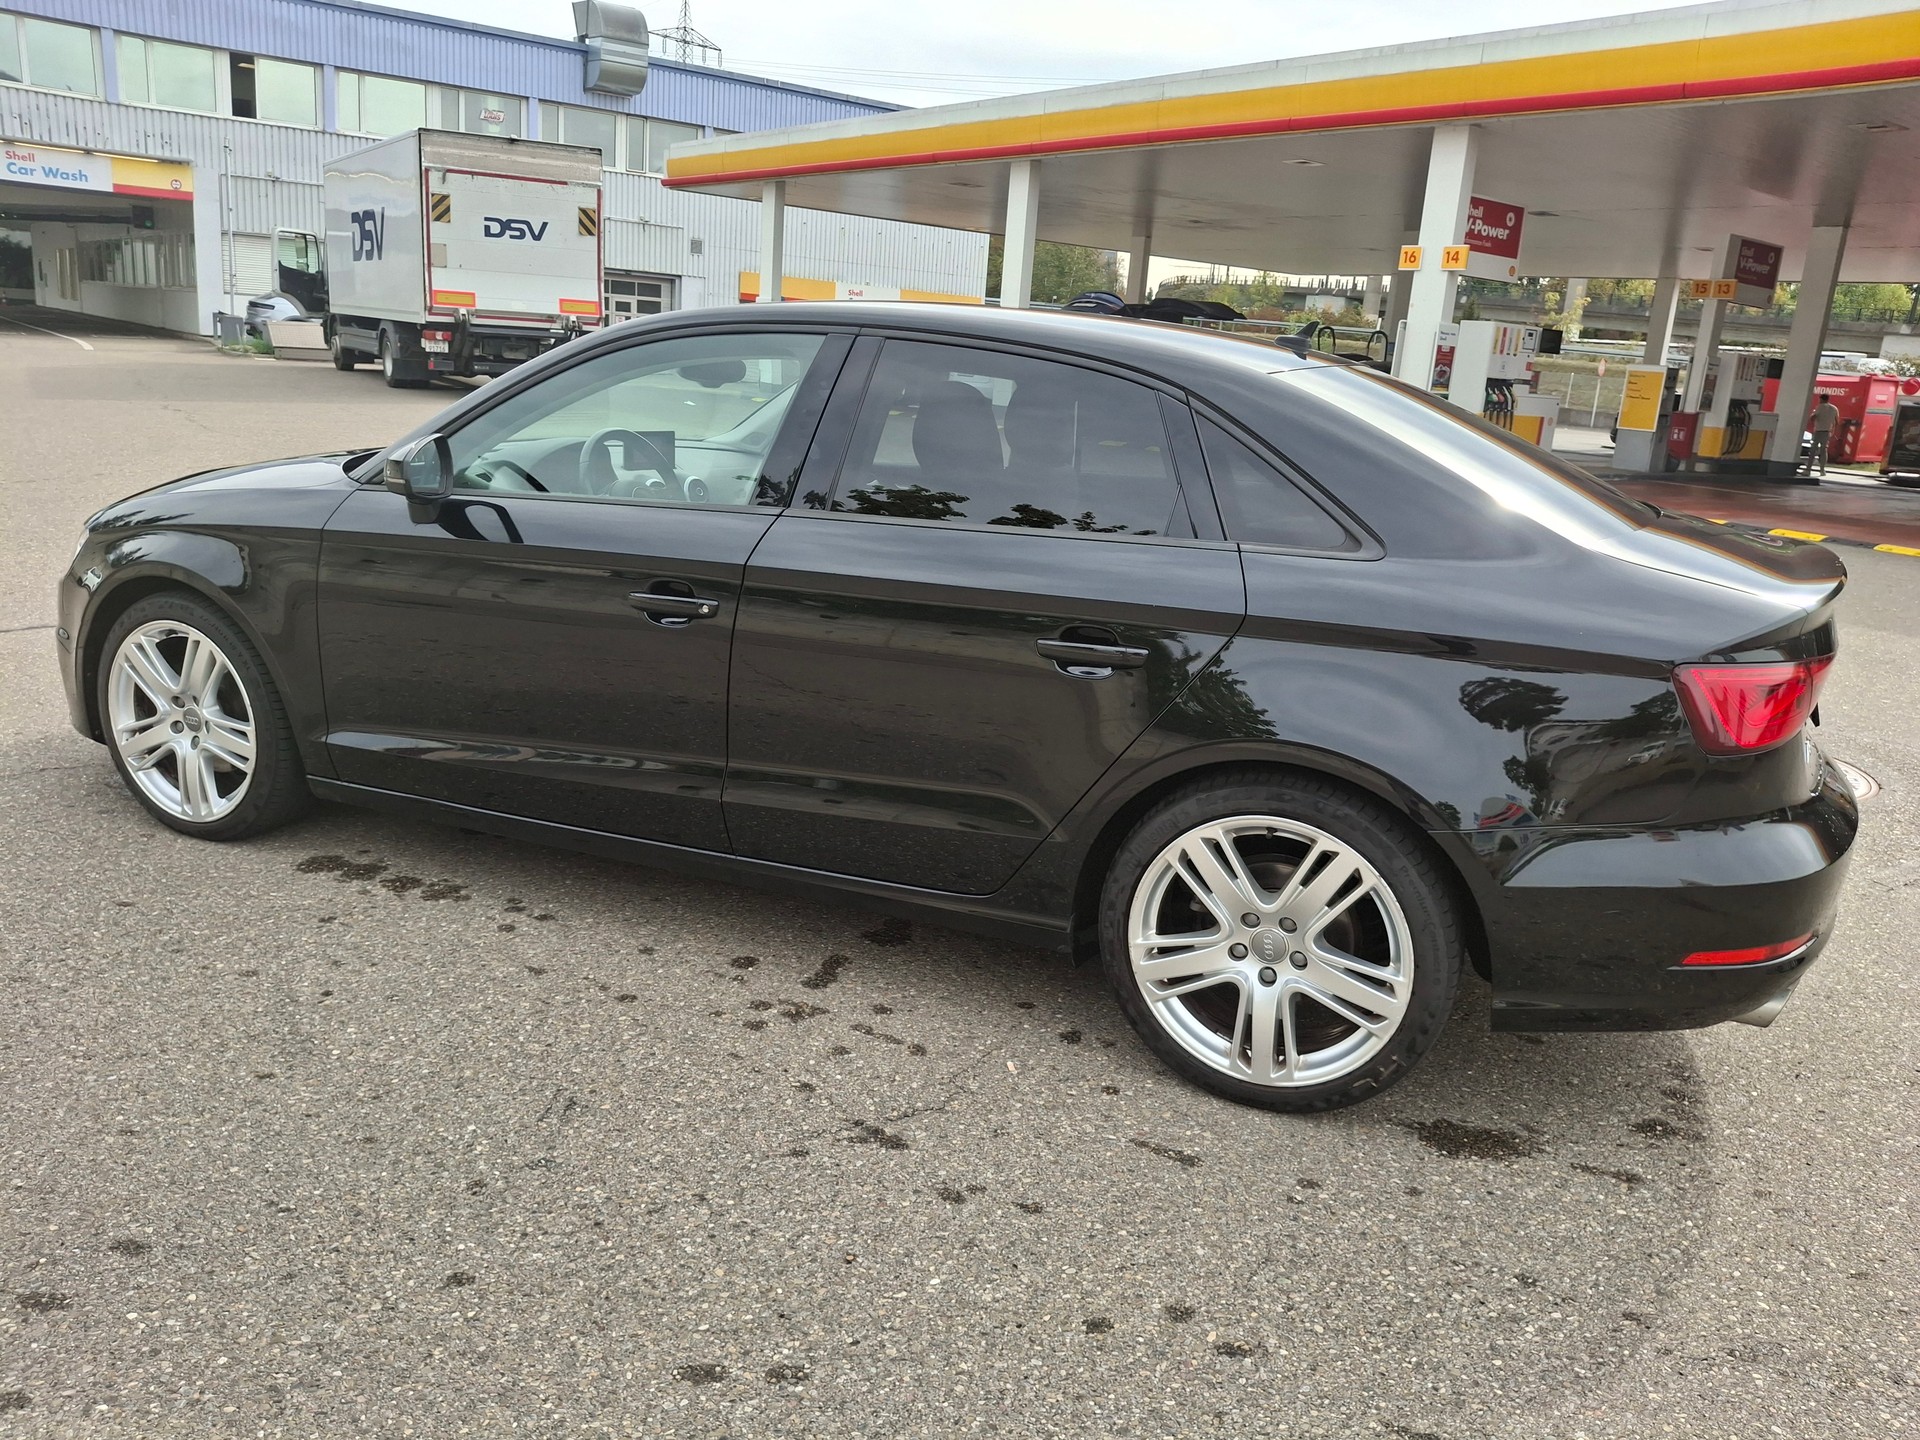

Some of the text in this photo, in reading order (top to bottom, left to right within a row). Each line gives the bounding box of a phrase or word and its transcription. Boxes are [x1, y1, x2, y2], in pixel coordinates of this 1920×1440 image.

[5, 150, 36, 163] Shell
[6, 161, 89, 183] Car Wash
[1468, 204, 1484, 218] hell
[351, 206, 385, 262] DSV
[483, 216, 549, 242] DSV
[1403, 250, 1417, 264] 16
[1445, 250, 1460, 264] 14
[848, 289, 864, 298] Shell
[1695, 283, 1708, 294] 15
[1717, 283, 1730, 295] 13
[1813, 386, 1845, 396] MONDIS
